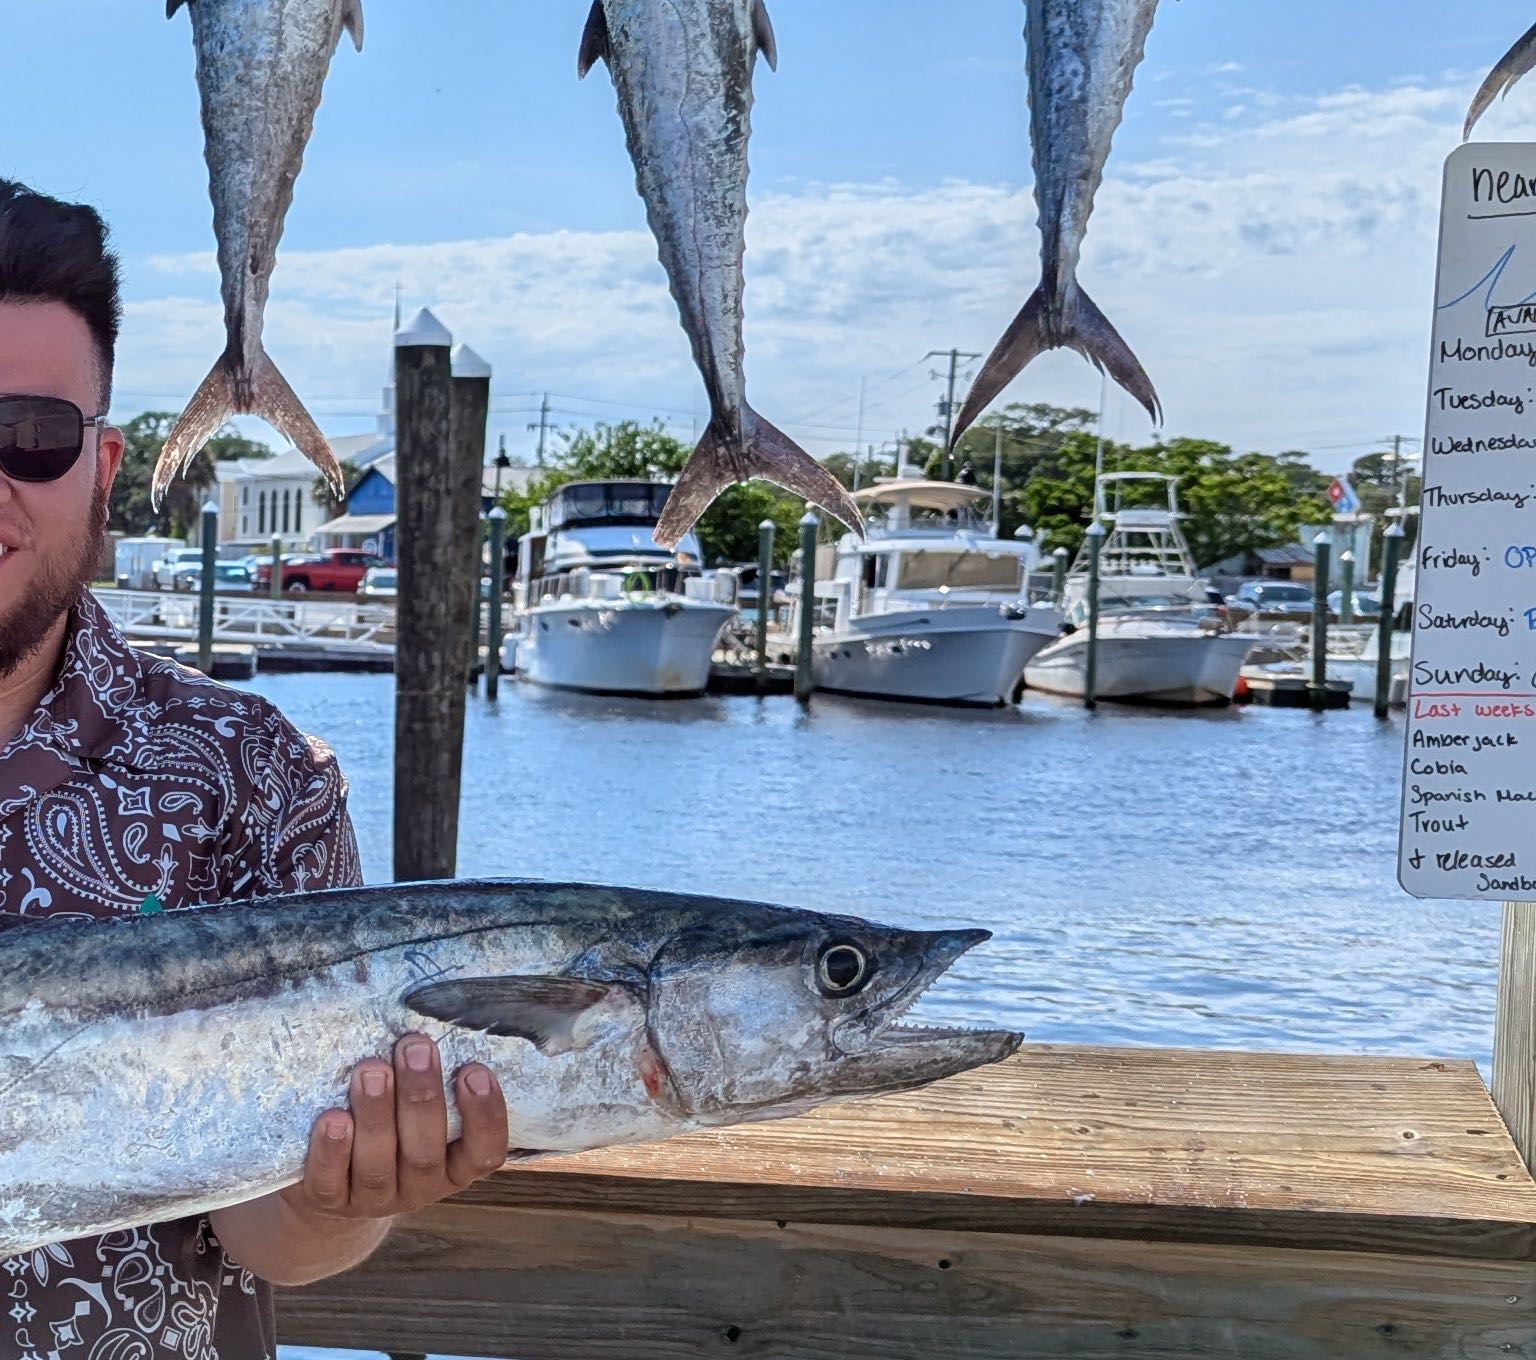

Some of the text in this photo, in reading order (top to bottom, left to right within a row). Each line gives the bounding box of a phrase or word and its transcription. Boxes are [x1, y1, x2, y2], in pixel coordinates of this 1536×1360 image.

[1414, 700, 1462, 720] Last
[1410, 758, 1468, 775] Cobia
[1410, 785, 1487, 807] Spanish
[1408, 811, 1469, 833] Trout
[1435, 849, 1517, 872] released
